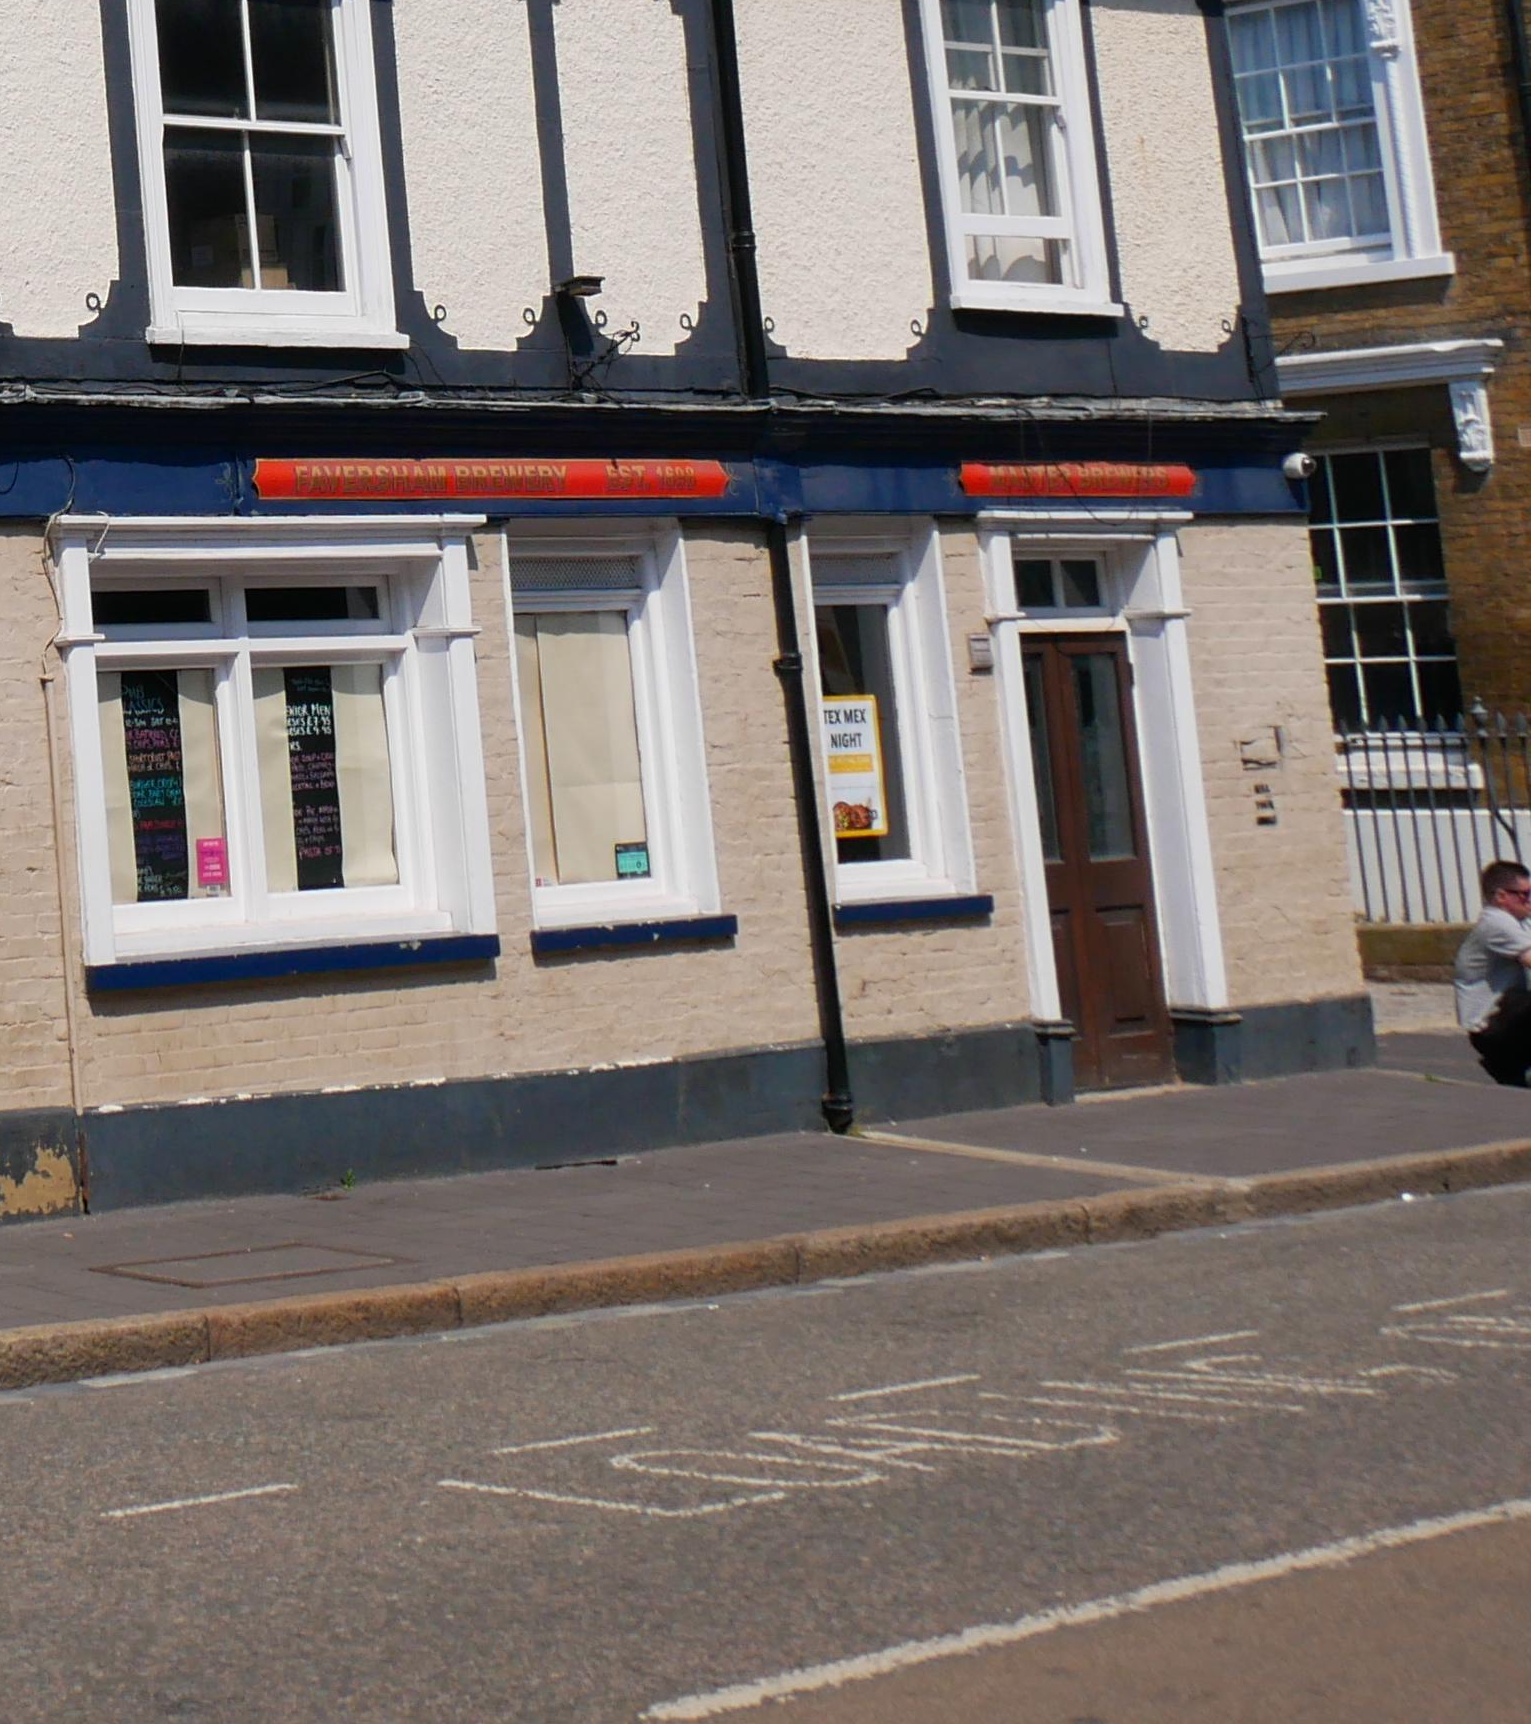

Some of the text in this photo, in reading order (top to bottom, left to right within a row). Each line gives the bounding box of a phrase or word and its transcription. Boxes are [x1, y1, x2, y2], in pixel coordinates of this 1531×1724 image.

[294, 465, 448, 493] FAVERSHAM
[454, 465, 568, 493] BREWERY
[1077, 464, 1170, 489] BREWERS
[823, 708, 867, 725] TEX MEX
[830, 733, 862, 749] NIGHT
